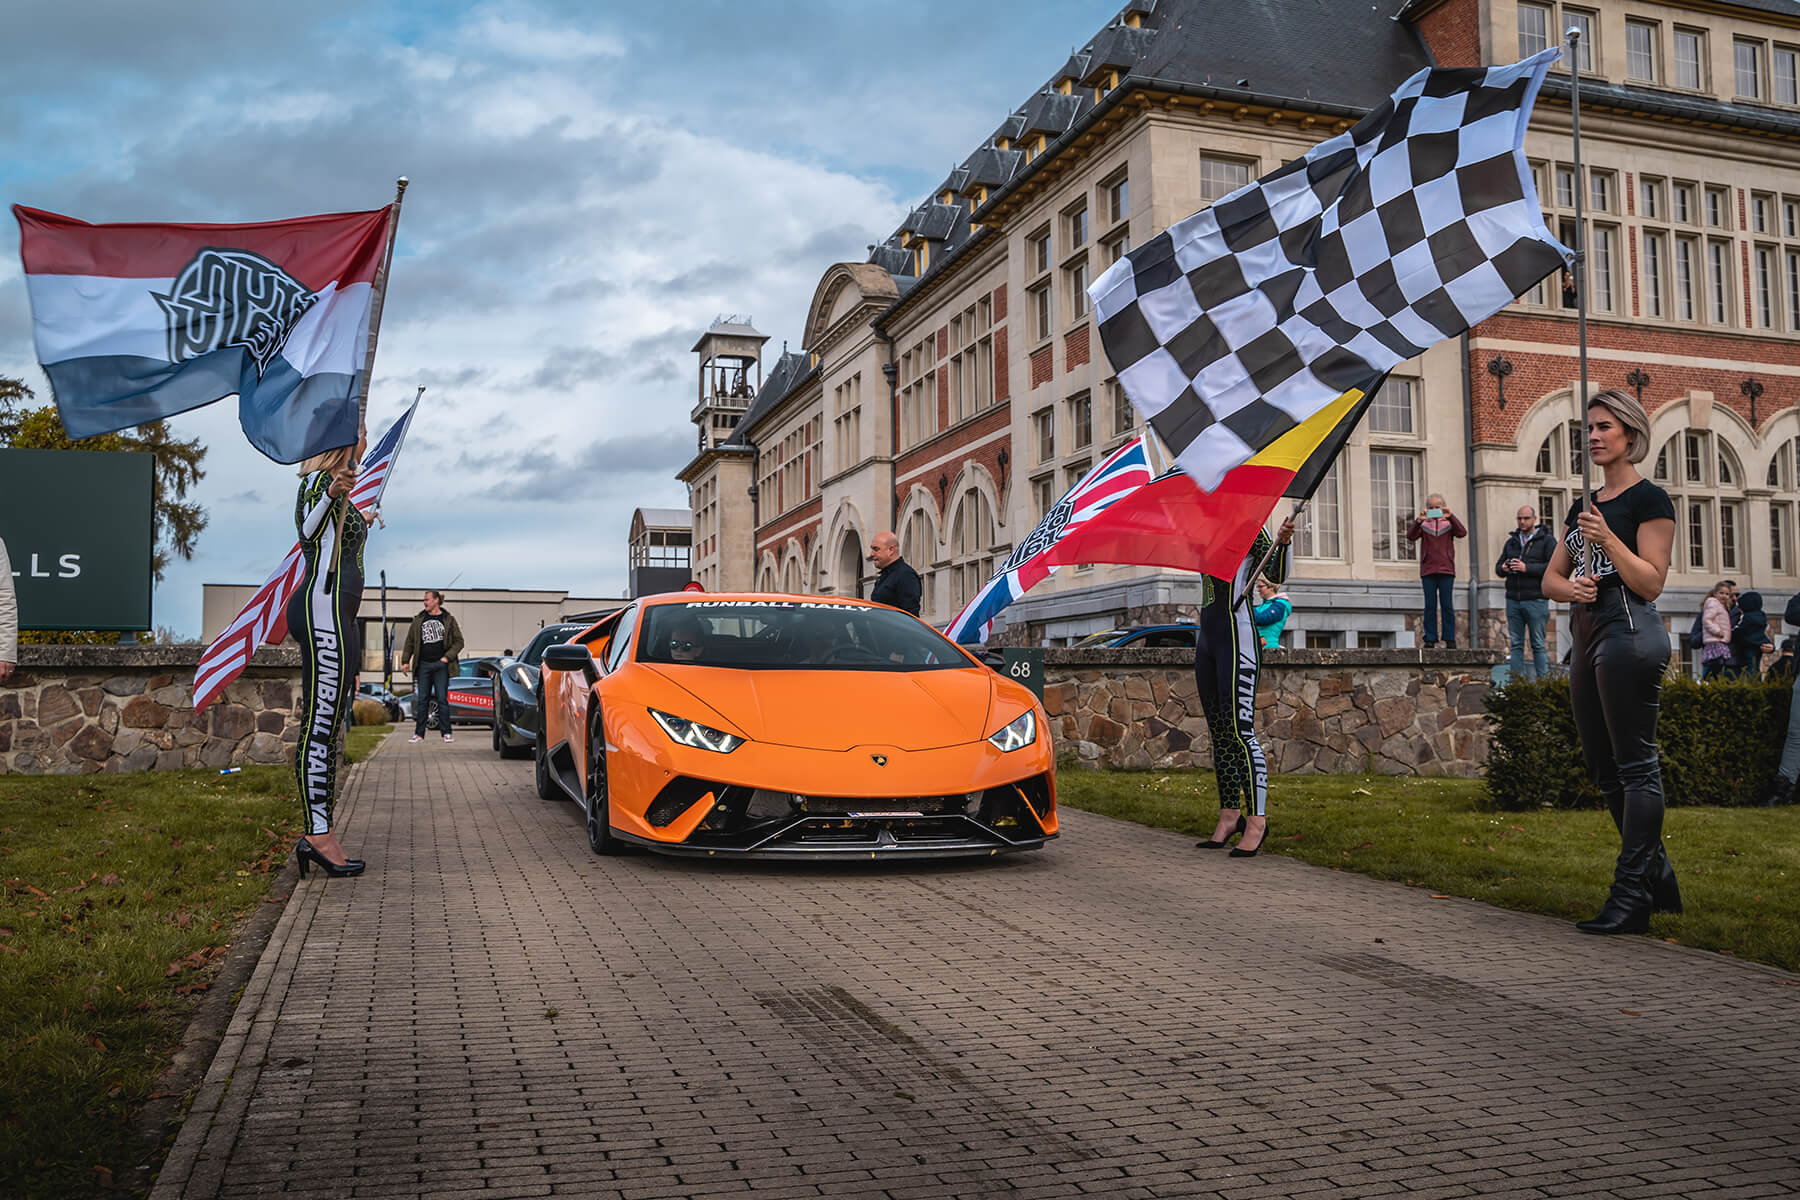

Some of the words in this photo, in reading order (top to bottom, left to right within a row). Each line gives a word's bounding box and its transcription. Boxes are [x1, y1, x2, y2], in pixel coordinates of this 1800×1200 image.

[11, 553, 81, 578] LS
[800, 602, 873, 612] RALLY
[310, 630, 339, 736] RUNBALL
[1010, 661, 1031, 678] 68
[1238, 653, 1257, 723] RALLY
[307, 740, 329, 816] RALLY
